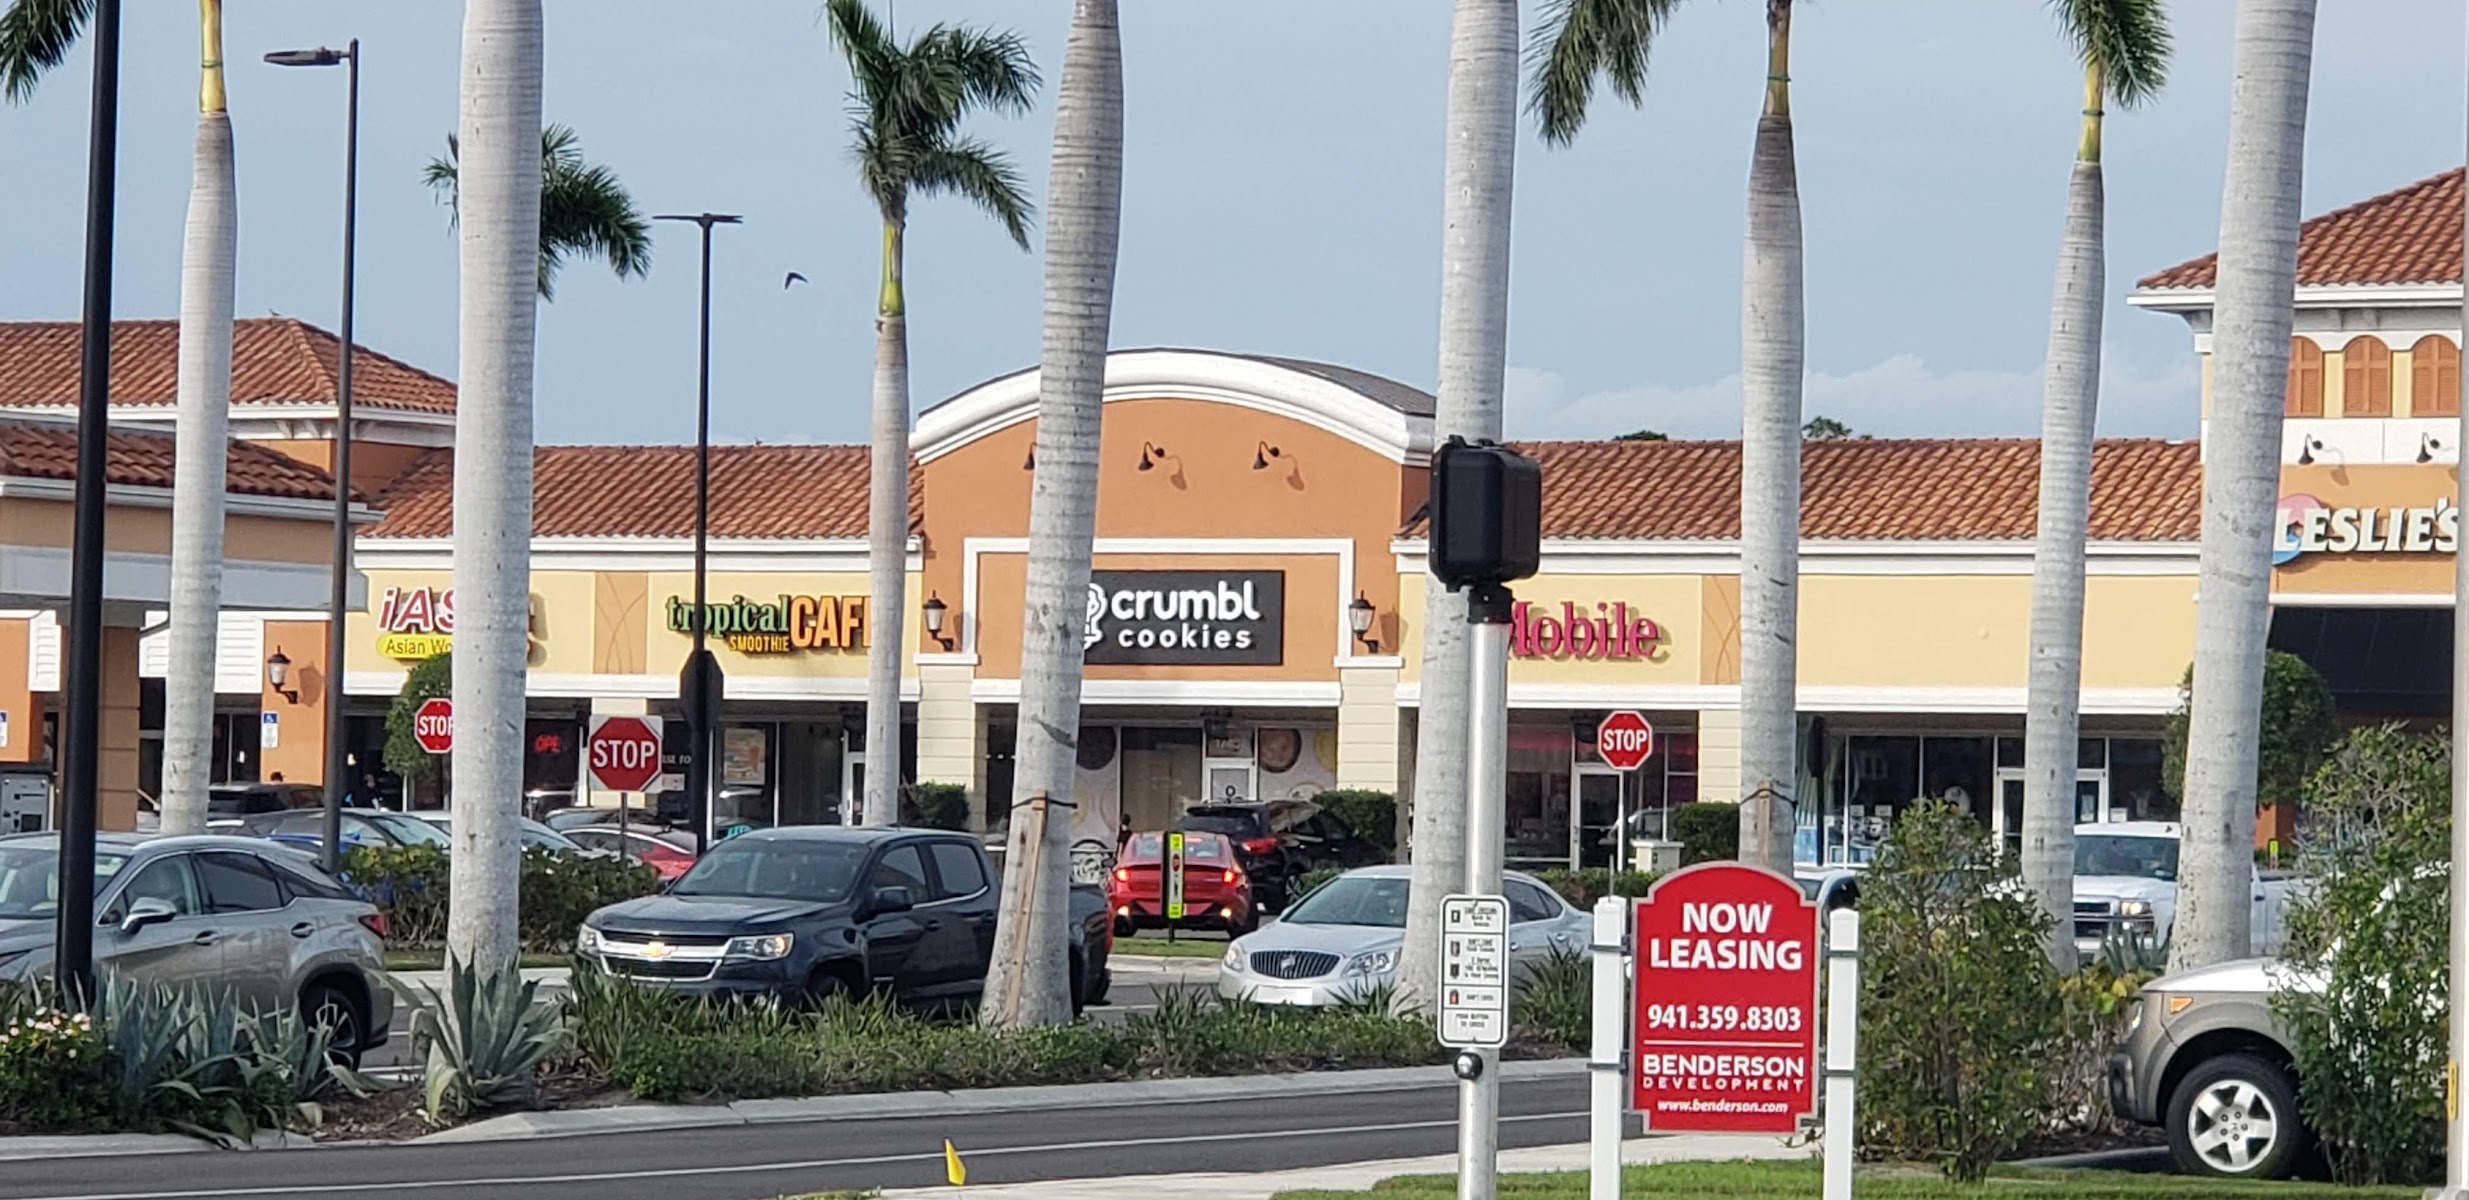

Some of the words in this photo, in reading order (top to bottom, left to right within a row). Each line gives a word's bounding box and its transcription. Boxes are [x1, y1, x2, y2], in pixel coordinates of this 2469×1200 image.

[2273, 496, 2459, 553] LESLIE'S
[1111, 580, 1261, 620] crumbl
[385, 638, 426, 654] Asian
[431, 639, 453, 654] Wo
[729, 634, 790, 653] SMOOTHIE
[1118, 623, 1252, 649] cookies
[1602, 729, 1648, 751] STOP
[593, 739, 656, 769] STOP
[1682, 902, 1773, 934] NOW
[1650, 938, 1802, 970] LEASING
[1648, 1004, 1801, 1031] 941.359.8303
[1643, 1054, 1804, 1077] BENDERSON
[1642, 1077, 1805, 1091] DEVELOPMENT
[1657, 1098, 1789, 1113] www.benderson.com
